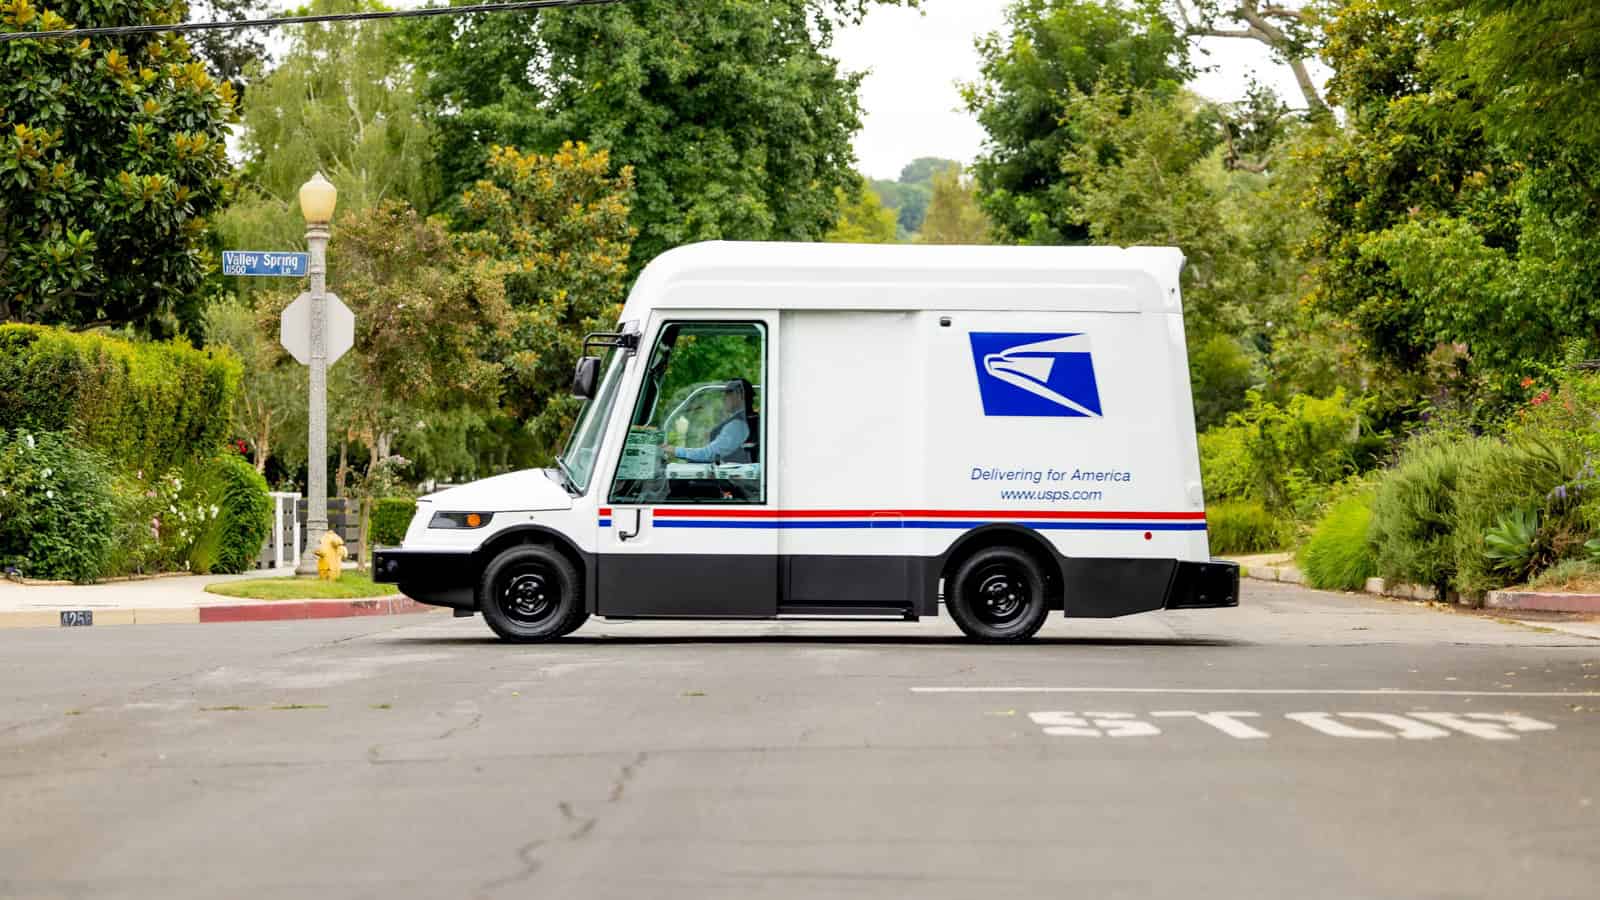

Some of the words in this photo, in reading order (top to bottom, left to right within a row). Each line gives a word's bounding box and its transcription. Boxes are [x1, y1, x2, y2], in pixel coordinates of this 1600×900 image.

[226, 253, 258, 268] Valley
[263, 254, 298, 270] Spring
[971, 467, 1042, 483] Delivering
[1047, 469, 1066, 482] for
[1071, 469, 1131, 482] America
[1000, 490, 1102, 502] www.usps.com
[1027, 711, 1557, 740] STOP
